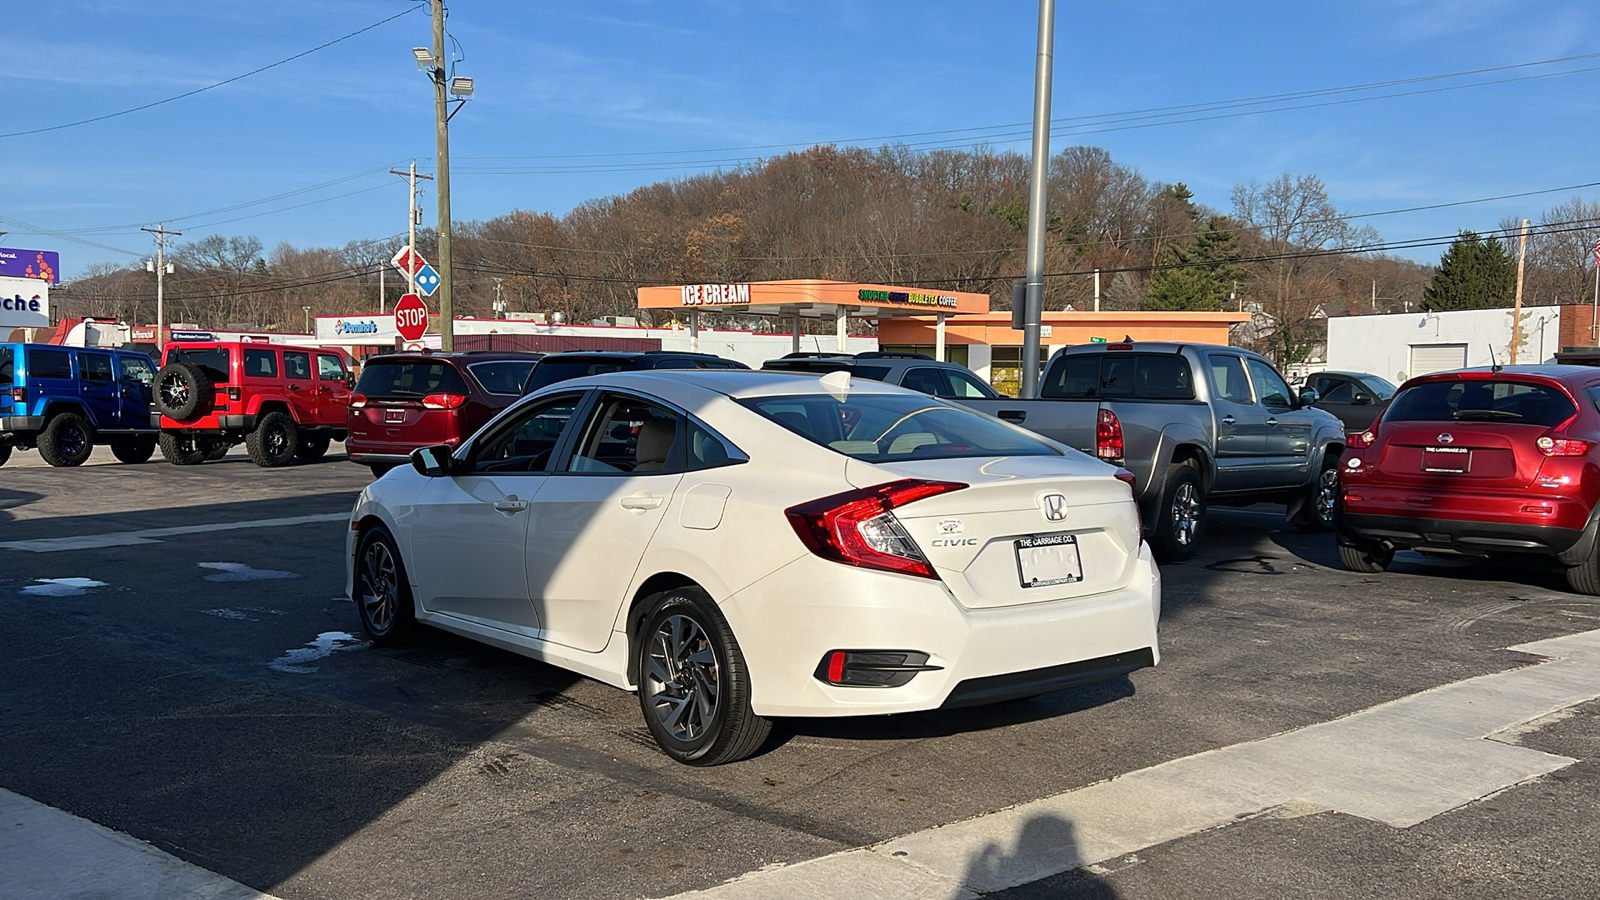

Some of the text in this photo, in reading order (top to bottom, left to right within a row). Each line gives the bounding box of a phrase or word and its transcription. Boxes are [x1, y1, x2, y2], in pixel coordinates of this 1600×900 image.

[682, 283, 751, 305] ICE CREAM
[938, 295, 957, 307] COFFEE
[397, 308, 425, 327] STOP
[343, 320, 377, 333] Domino's
[931, 538, 977, 547] CIVIC
[1020, 535, 1074, 547] THE CARRIAGE CO.
